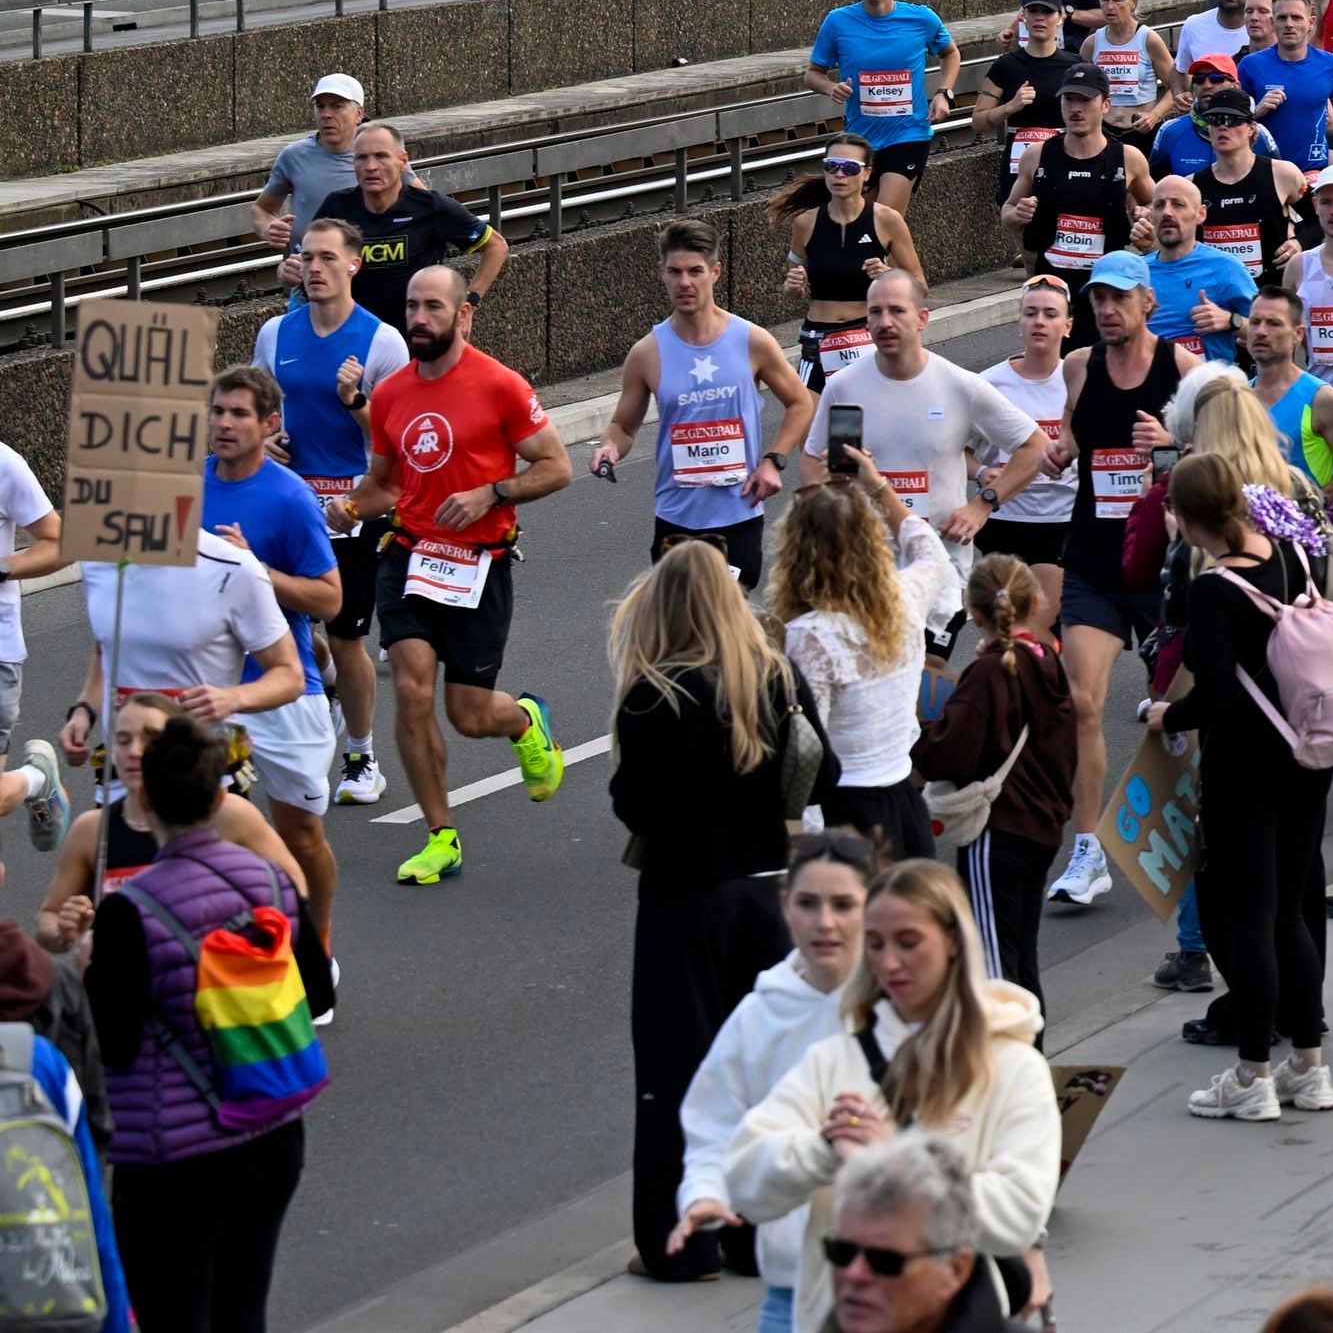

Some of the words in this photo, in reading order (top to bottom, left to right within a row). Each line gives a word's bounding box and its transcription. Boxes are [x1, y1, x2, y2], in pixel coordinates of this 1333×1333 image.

[1104, 54, 1137, 62] GENERALI
[871, 73, 909, 83] GENERALI
[868, 86, 904, 98] Kelsey
[1068, 170, 1091, 179] form
[1221, 196, 1244, 208] form
[1057, 231, 1093, 246] Robin
[1213, 227, 1259, 240] GENERALI
[831, 332, 872, 346] GENERALI
[81, 312, 208, 386] QUÄL
[839, 348, 860, 361] Nhi
[678, 385, 738, 406] SAYSKY
[79, 411, 199, 461] DICH
[687, 423, 741, 438] GENERALI
[687, 443, 730, 458] Mario
[70, 477, 112, 505] DU
[420, 557, 458, 577] Felix
[1116, 775, 1153, 844] GO
